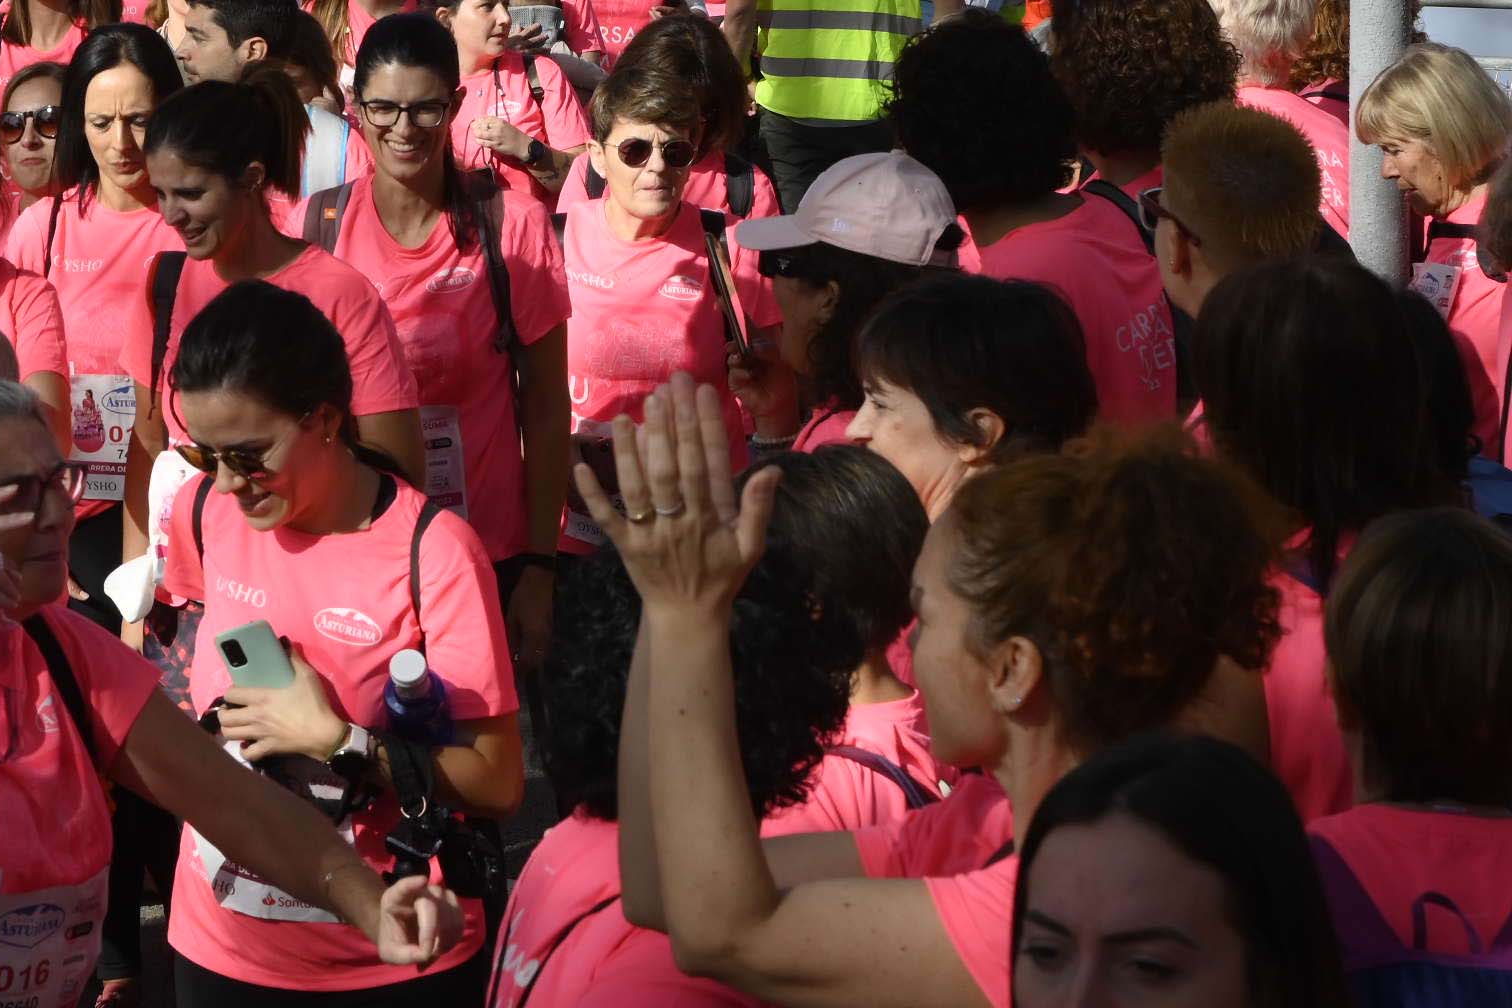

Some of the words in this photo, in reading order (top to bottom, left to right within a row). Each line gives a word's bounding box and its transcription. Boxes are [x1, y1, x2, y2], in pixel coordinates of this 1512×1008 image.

[599, 26, 637, 43] RSA
[107, 397, 135, 408] ASTUR
[87, 480, 117, 492] YSHO
[319, 616, 376, 643] ASTURIANA
[277, 896, 320, 910] Santa
